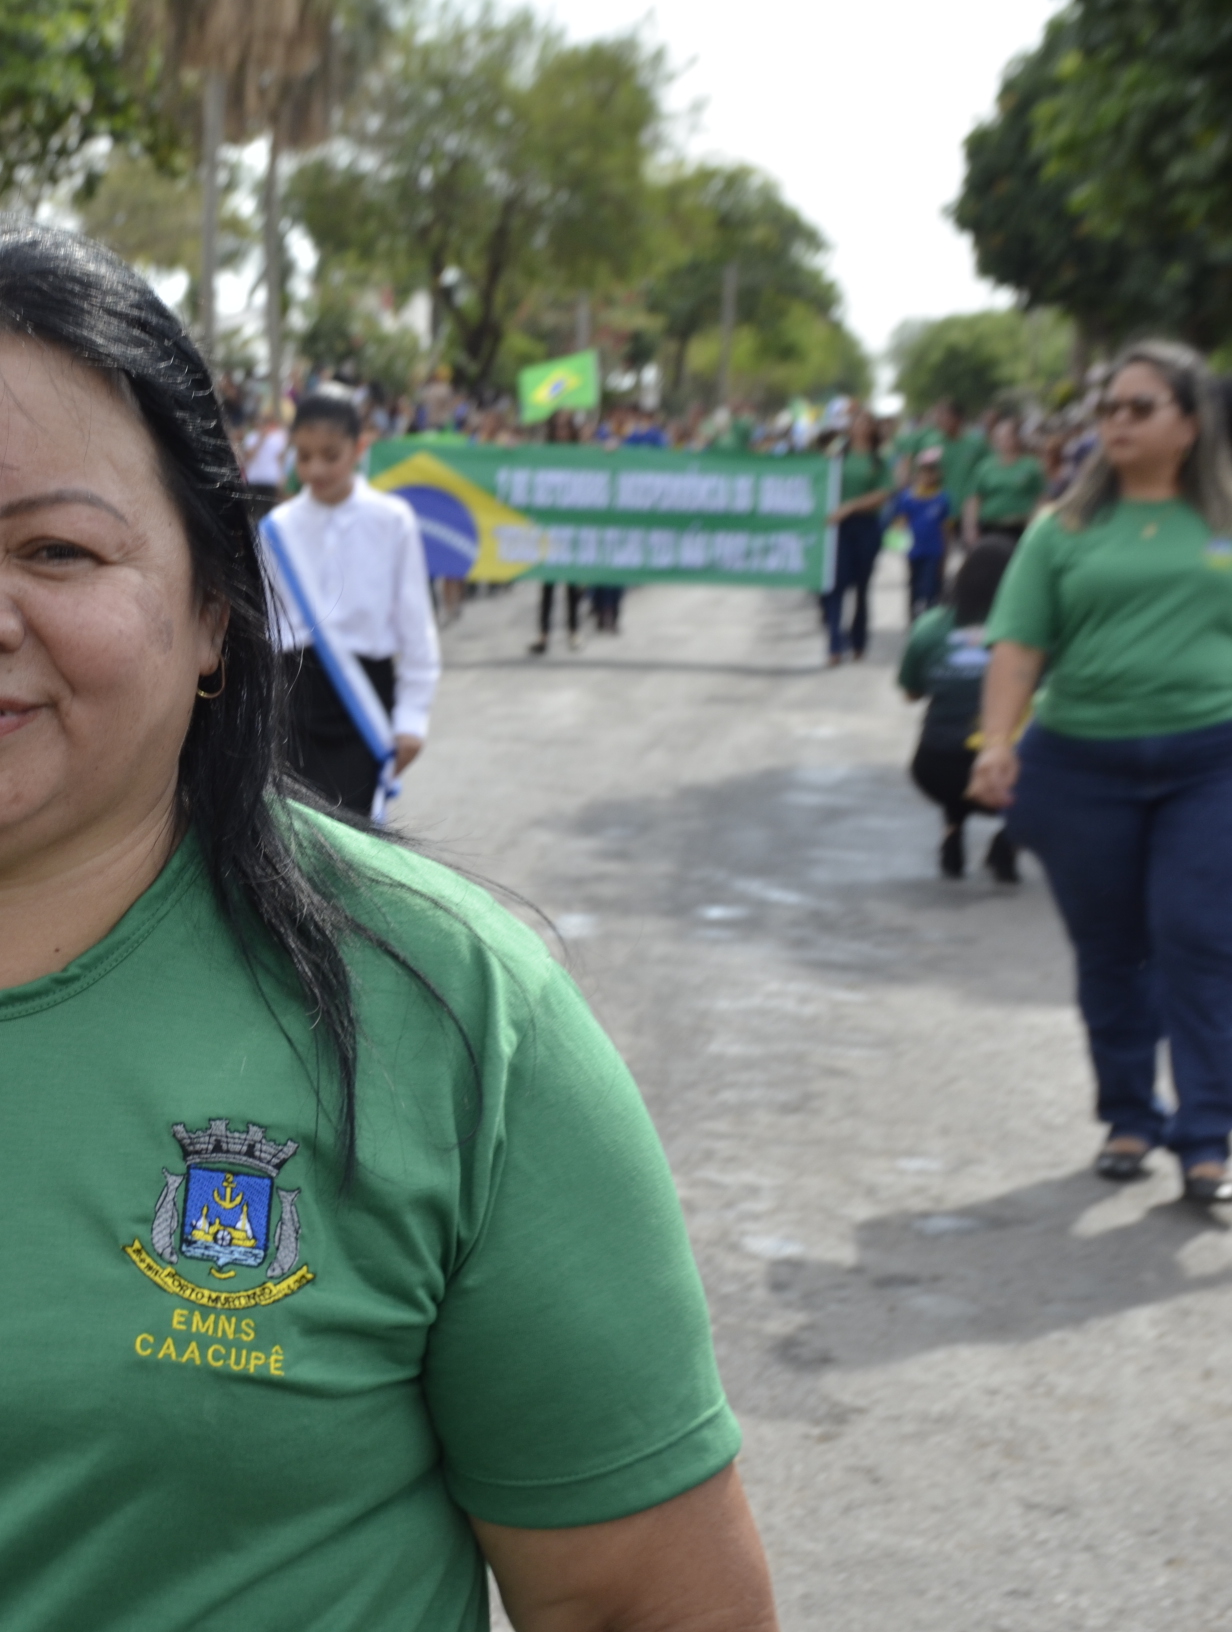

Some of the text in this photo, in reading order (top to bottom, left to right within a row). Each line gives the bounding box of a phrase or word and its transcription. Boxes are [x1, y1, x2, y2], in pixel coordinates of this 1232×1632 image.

[164, 1270, 205, 1302] PORTO
[171, 1308, 256, 1342] EMNS
[134, 1333, 285, 1376] CAACUPÊ
